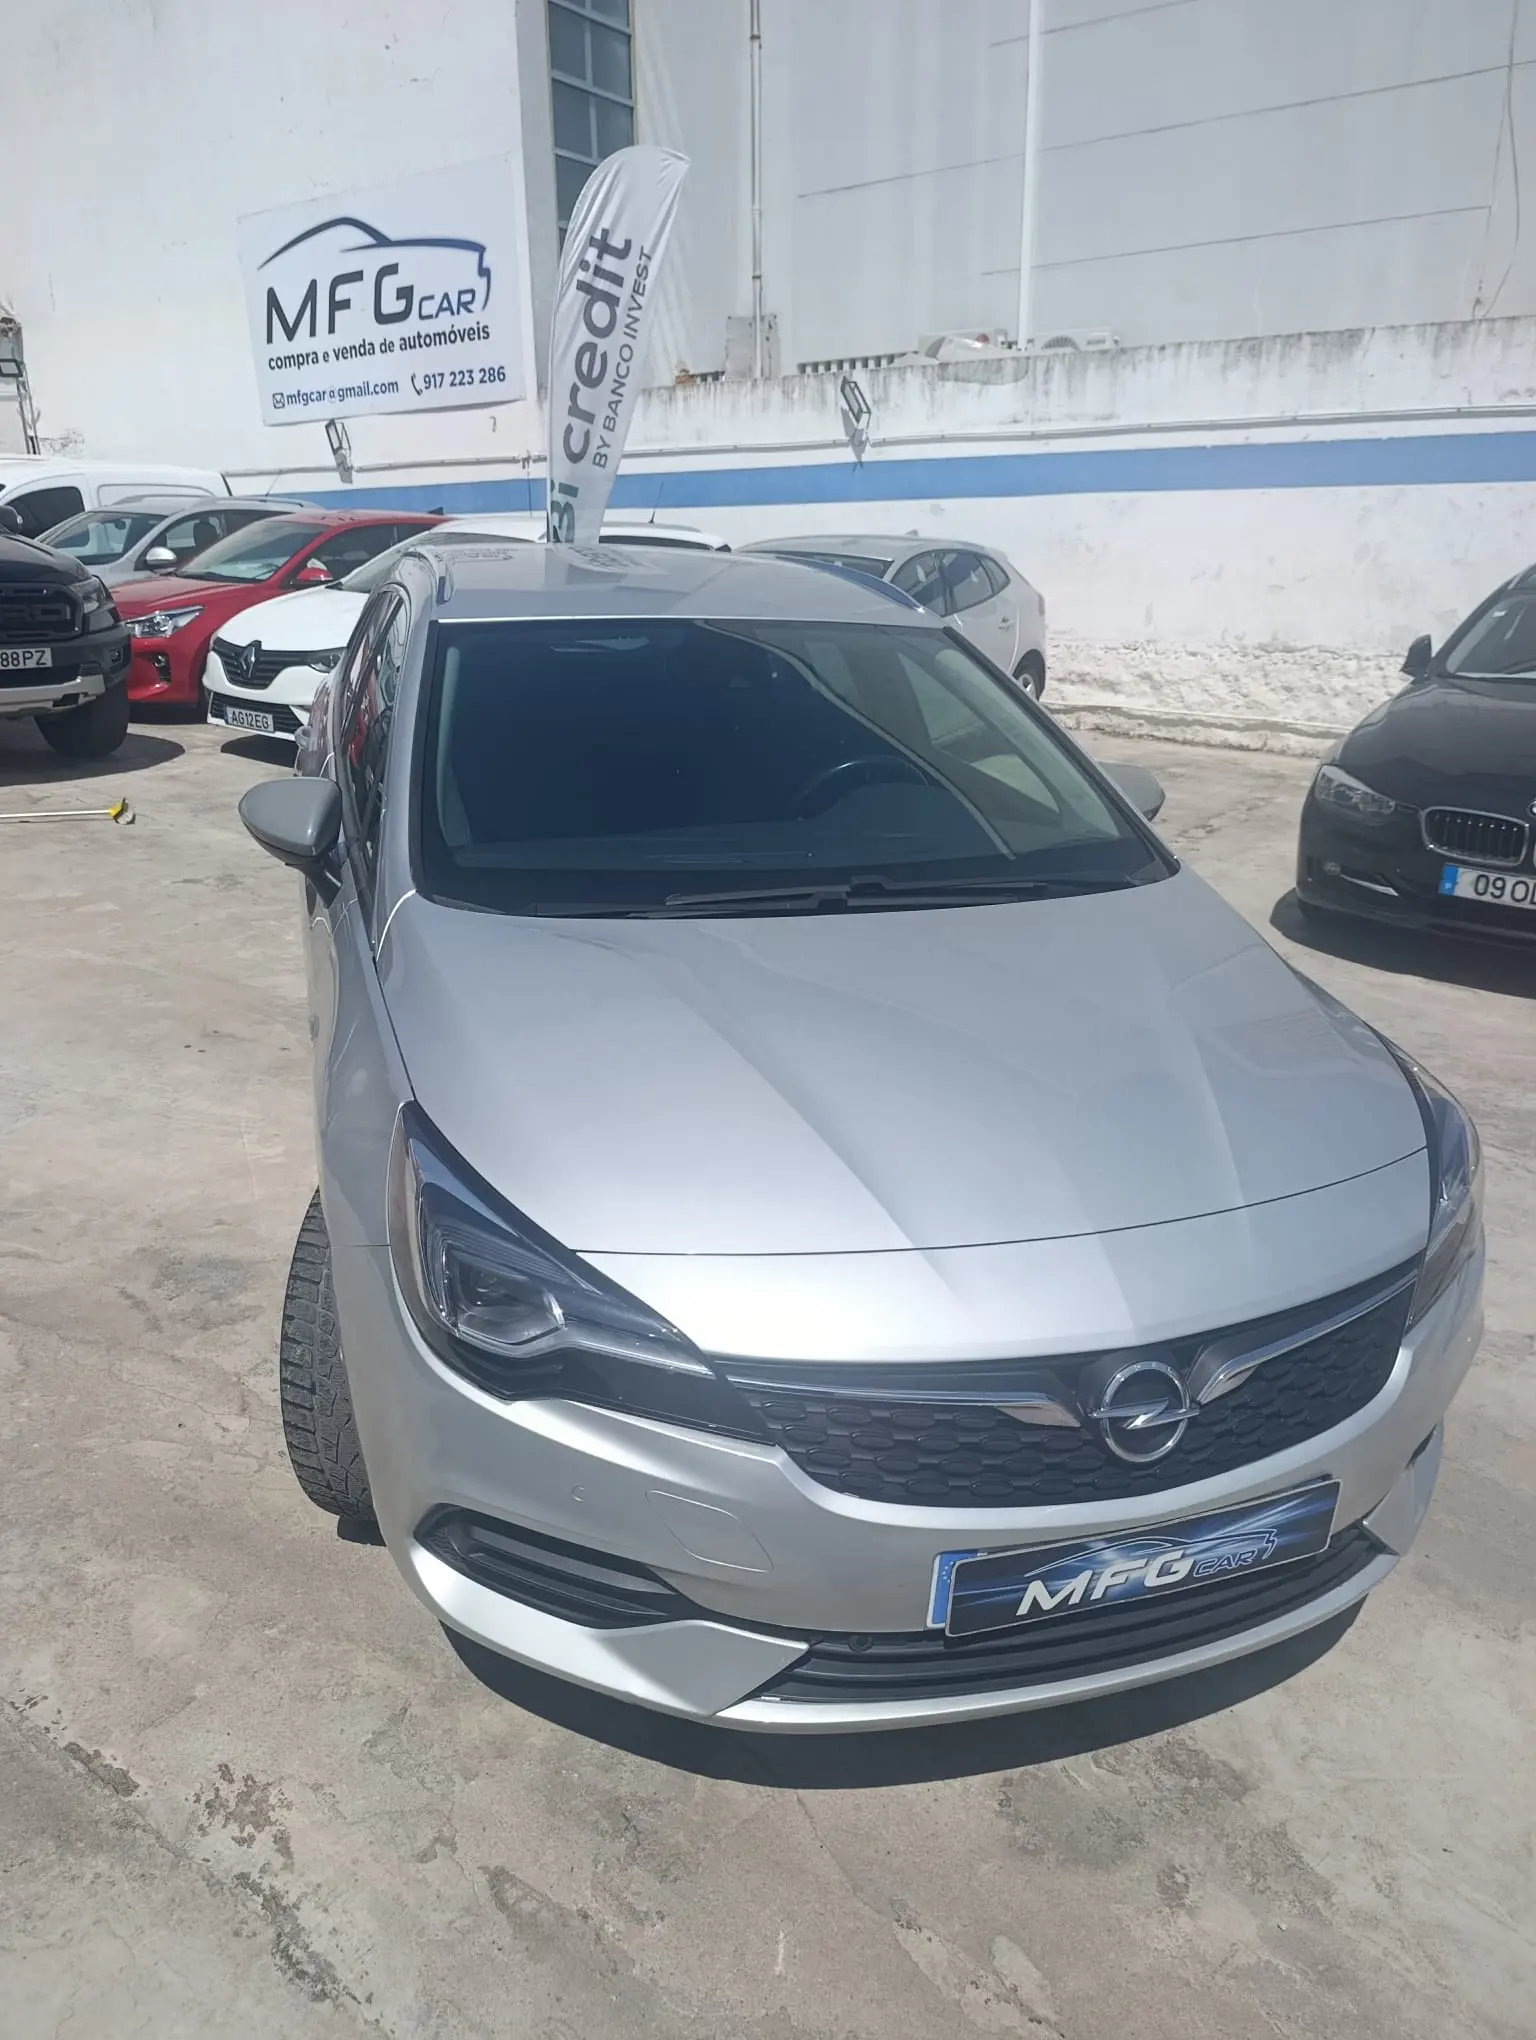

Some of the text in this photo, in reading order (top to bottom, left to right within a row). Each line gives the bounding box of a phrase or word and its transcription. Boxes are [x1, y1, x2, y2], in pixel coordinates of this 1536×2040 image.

[266, 262, 476, 345] MFG CAR
[268, 320, 491, 372] compra e venda de automóveis
[423, 366, 506, 391] 917 223 286
[562, 227, 632, 465] credit
[592, 245, 653, 469] BY BANCO INVEST
[1016, 1549, 1256, 1616] MFG CAR
